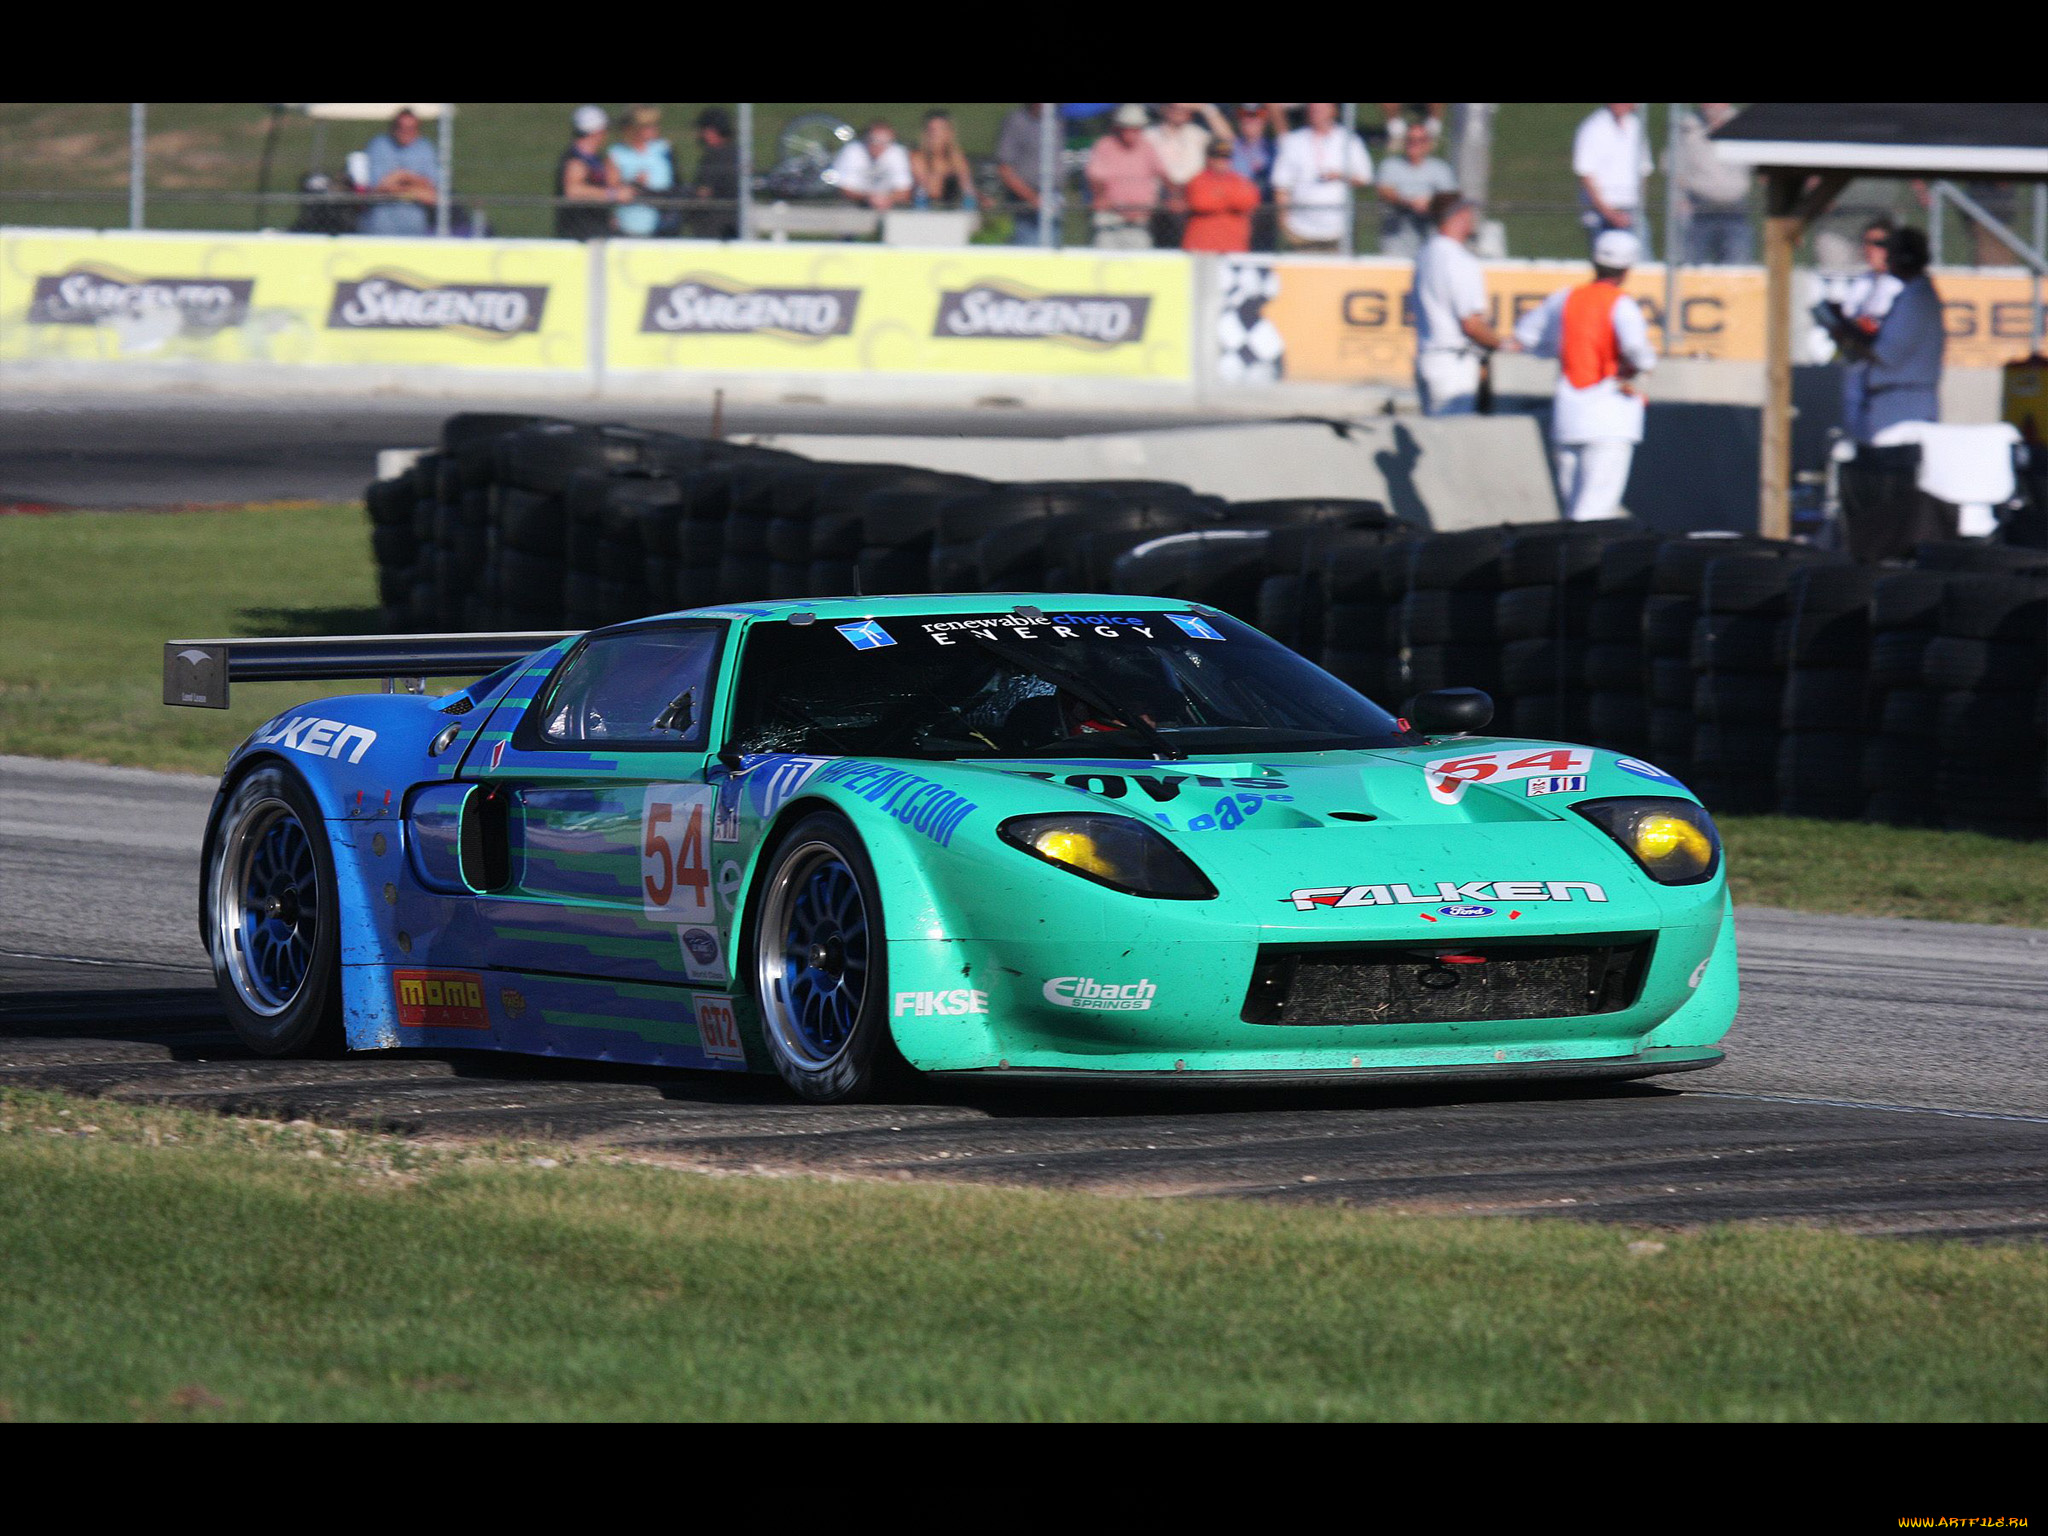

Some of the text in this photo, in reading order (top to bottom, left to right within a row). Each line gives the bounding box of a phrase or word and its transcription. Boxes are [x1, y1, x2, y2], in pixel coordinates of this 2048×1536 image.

[342, 280, 528, 331] SARGENTO
[655, 284, 840, 334] SARGENTO
[948, 290, 1131, 341] SARGENTO
[921, 614, 1144, 632] renewable choice
[1433, 750, 1582, 793] 54
[644, 803, 709, 908] 54
[1289, 881, 1608, 911] FALKEN
[1450, 906, 1485, 915] Ford
[894, 989, 989, 1018] FIKSE
[1042, 976, 1157, 1010] Eibach
[1072, 999, 1143, 1009] SPRINGS
[701, 1005, 738, 1048] GT2
